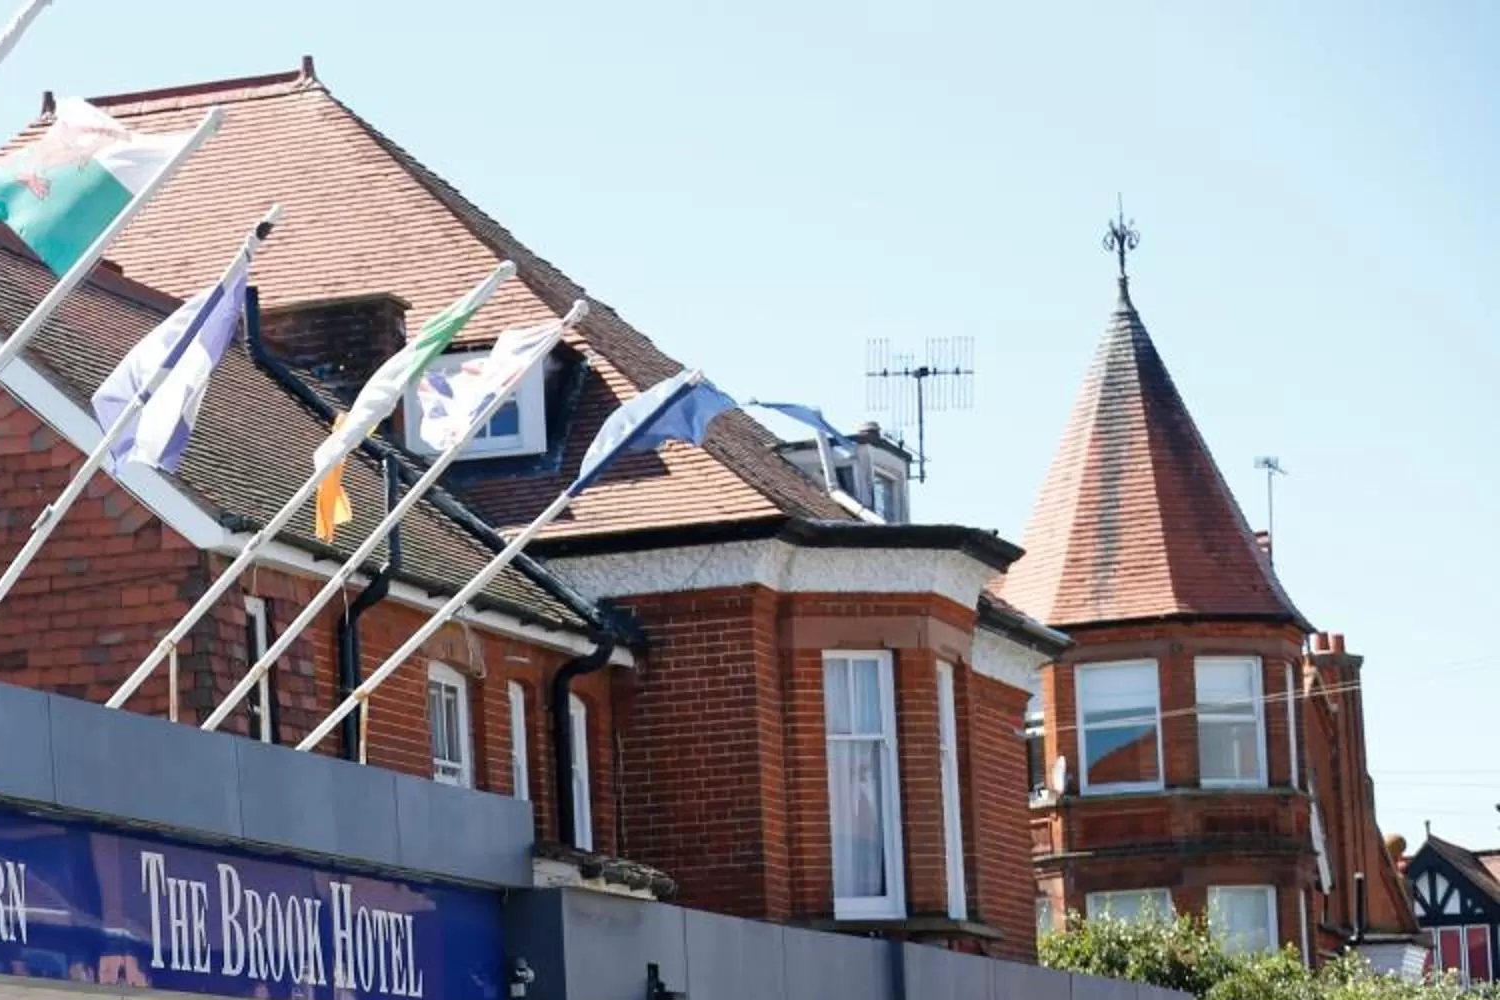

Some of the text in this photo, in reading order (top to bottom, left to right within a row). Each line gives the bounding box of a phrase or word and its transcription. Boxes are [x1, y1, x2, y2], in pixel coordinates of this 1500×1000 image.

[140, 851, 423, 999] THE BROOK HOTEL
